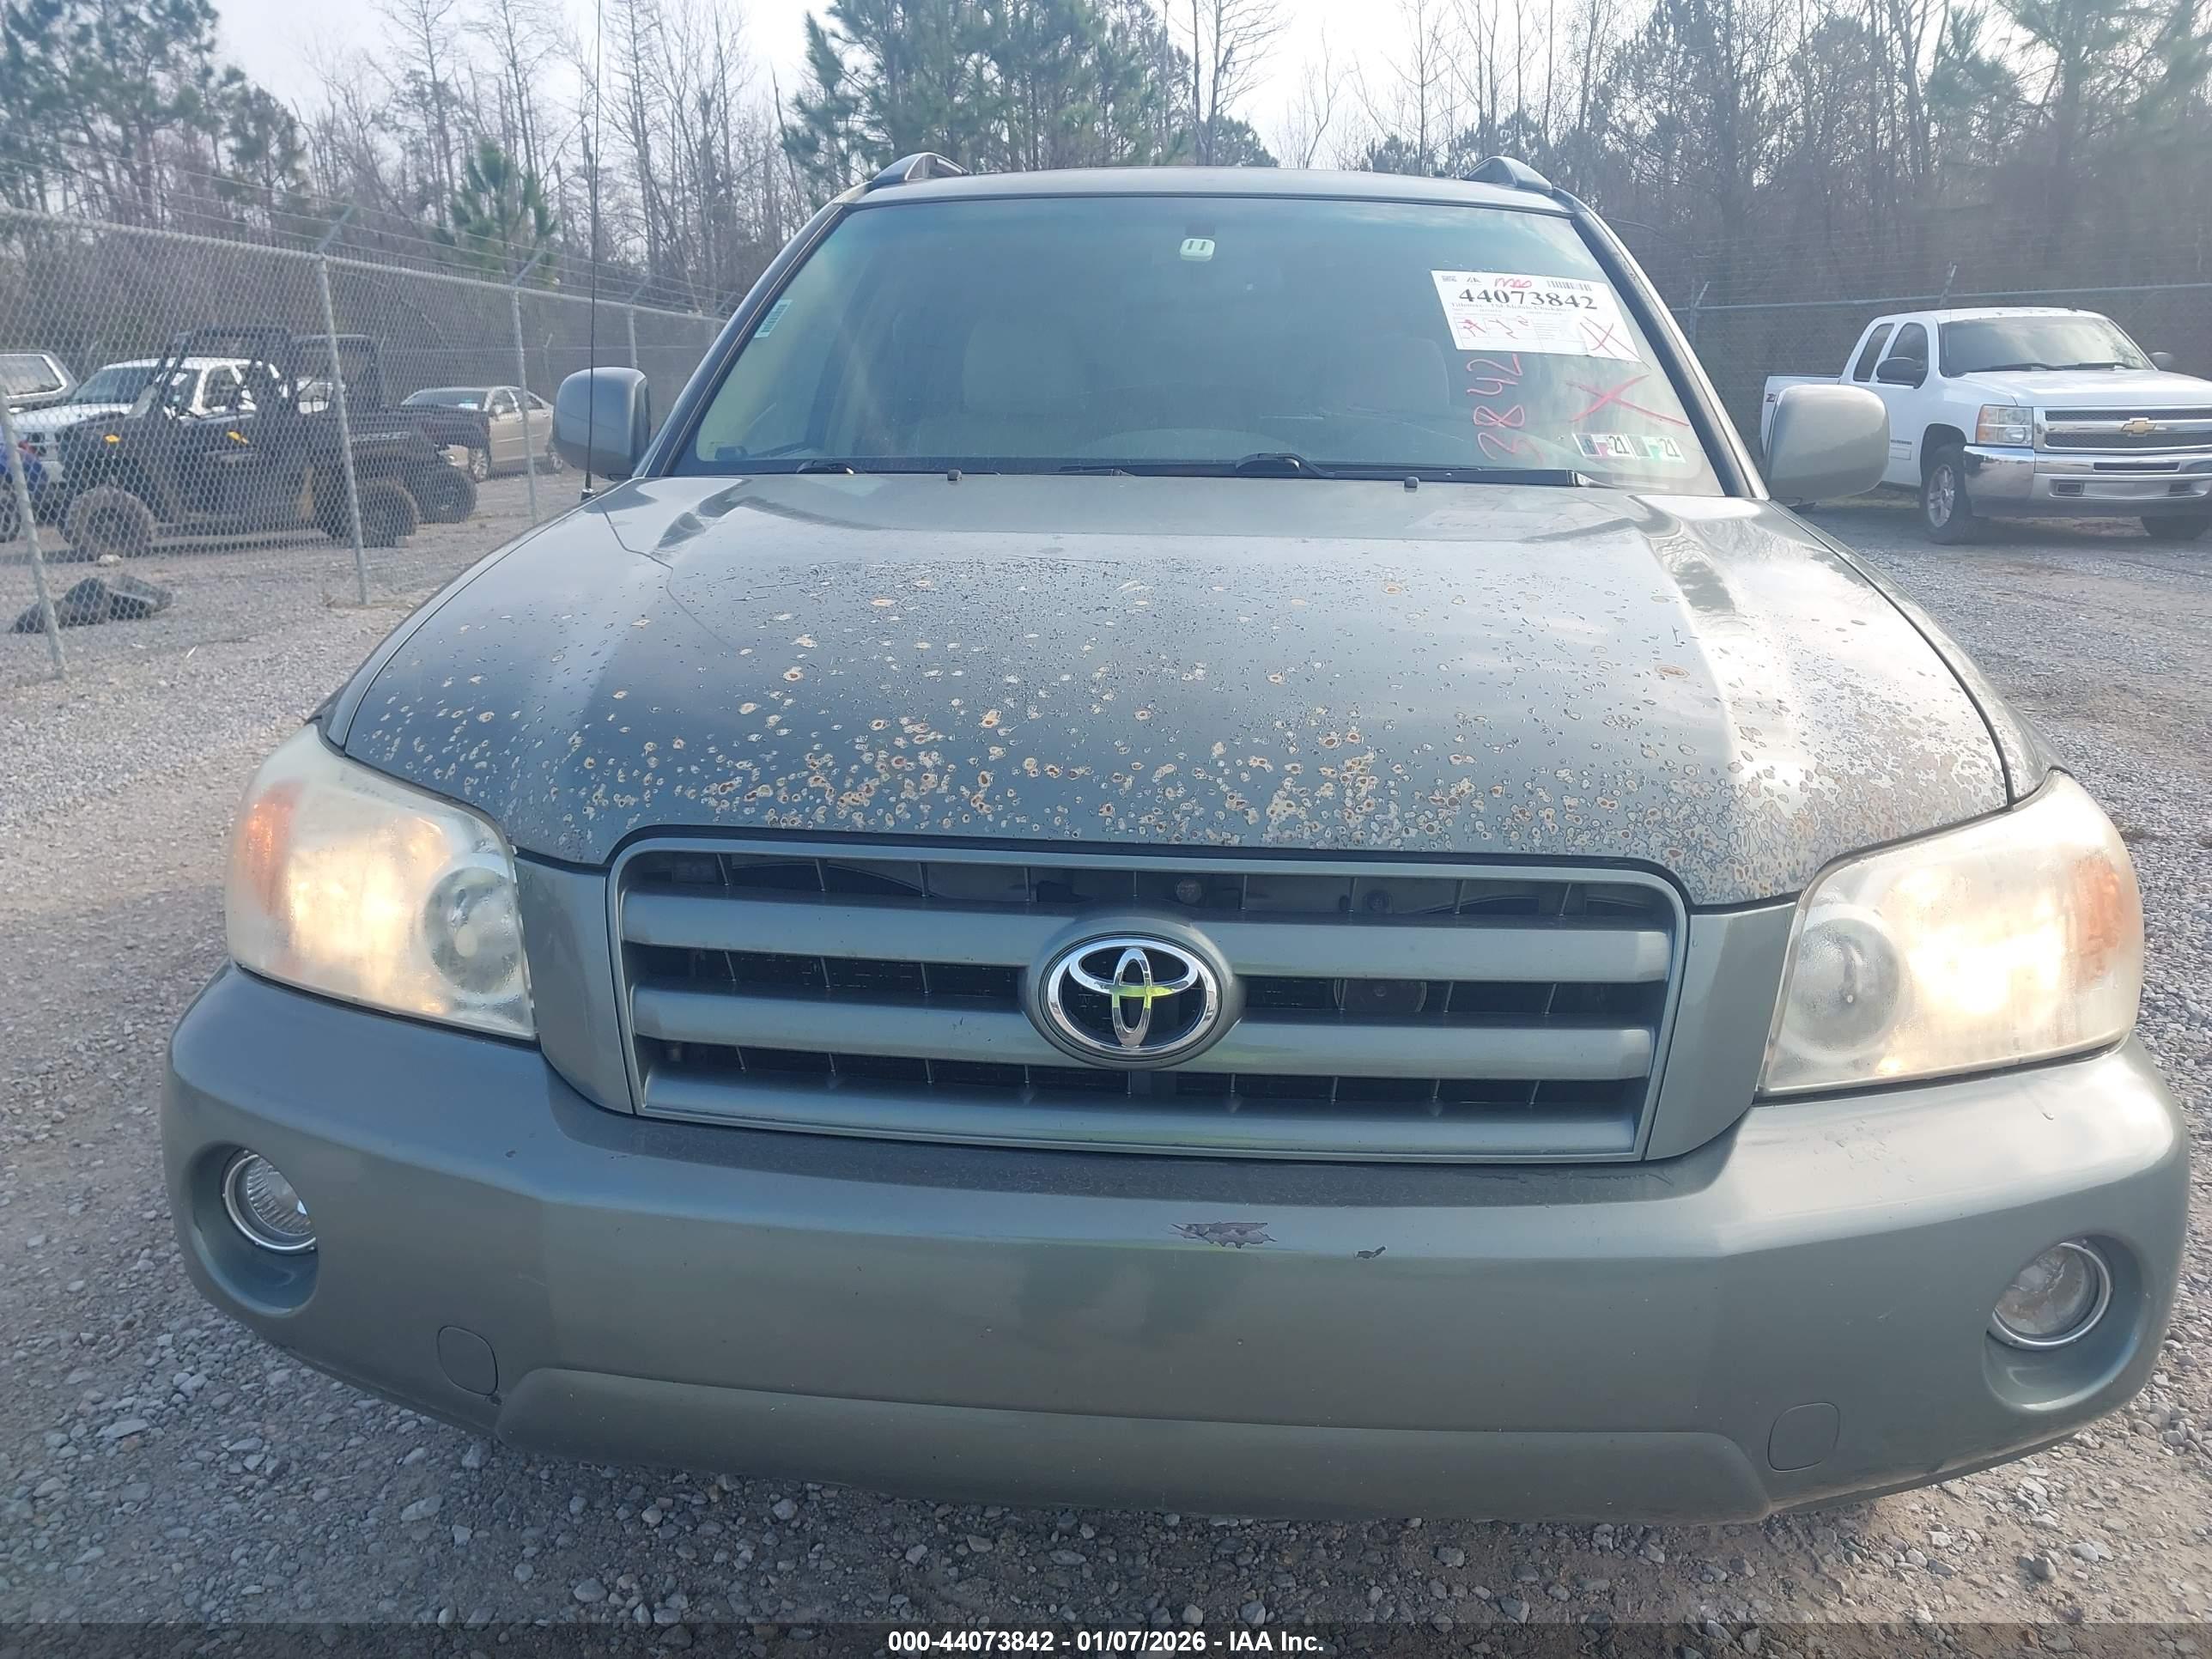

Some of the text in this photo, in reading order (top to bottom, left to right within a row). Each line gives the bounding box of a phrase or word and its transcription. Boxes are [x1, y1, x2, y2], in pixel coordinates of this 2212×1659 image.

[1459, 288, 1598, 310] 44073842
[1466, 353, 1544, 462] 3842
[1608, 435, 1630, 455] 21
[1659, 438, 1680, 458] 21
